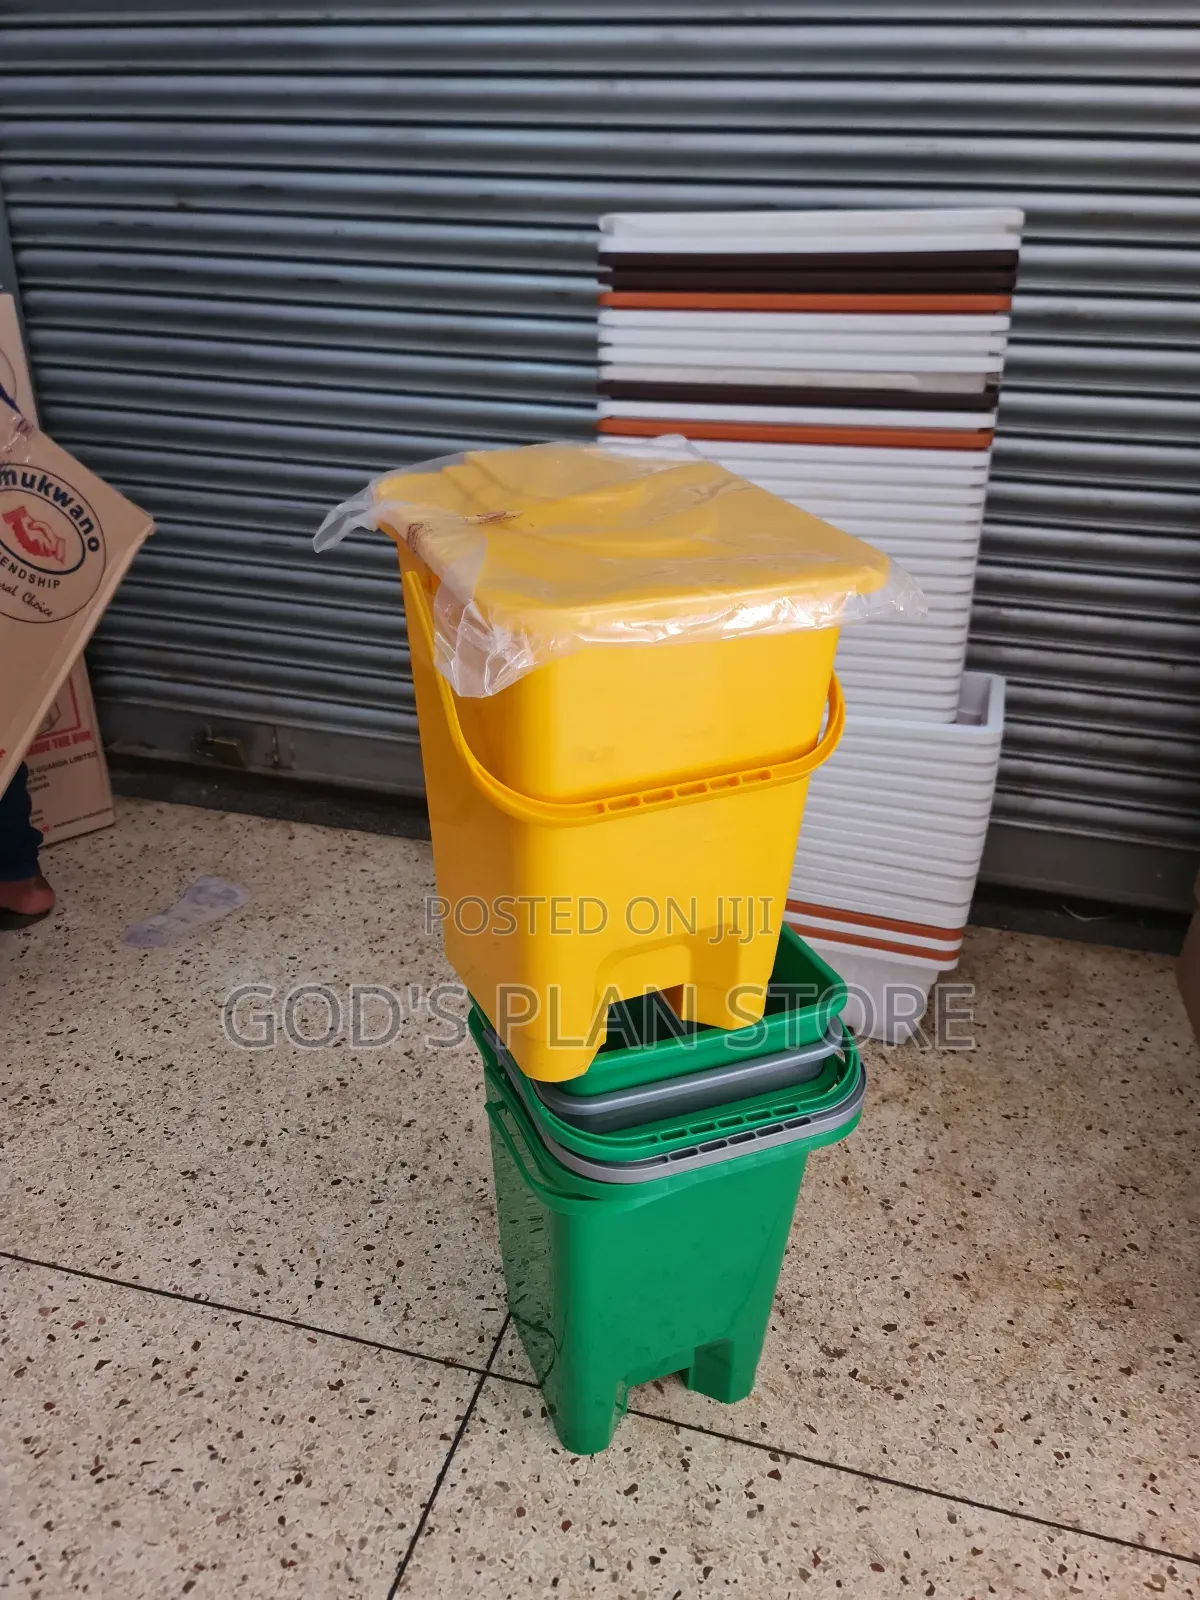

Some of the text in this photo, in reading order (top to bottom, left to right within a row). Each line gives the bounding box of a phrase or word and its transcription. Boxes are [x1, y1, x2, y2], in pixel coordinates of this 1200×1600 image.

[0, 469, 100, 552] mukwano
[0, 552, 61, 589] ENDSHIP
[22, 592, 53, 617] Choice
